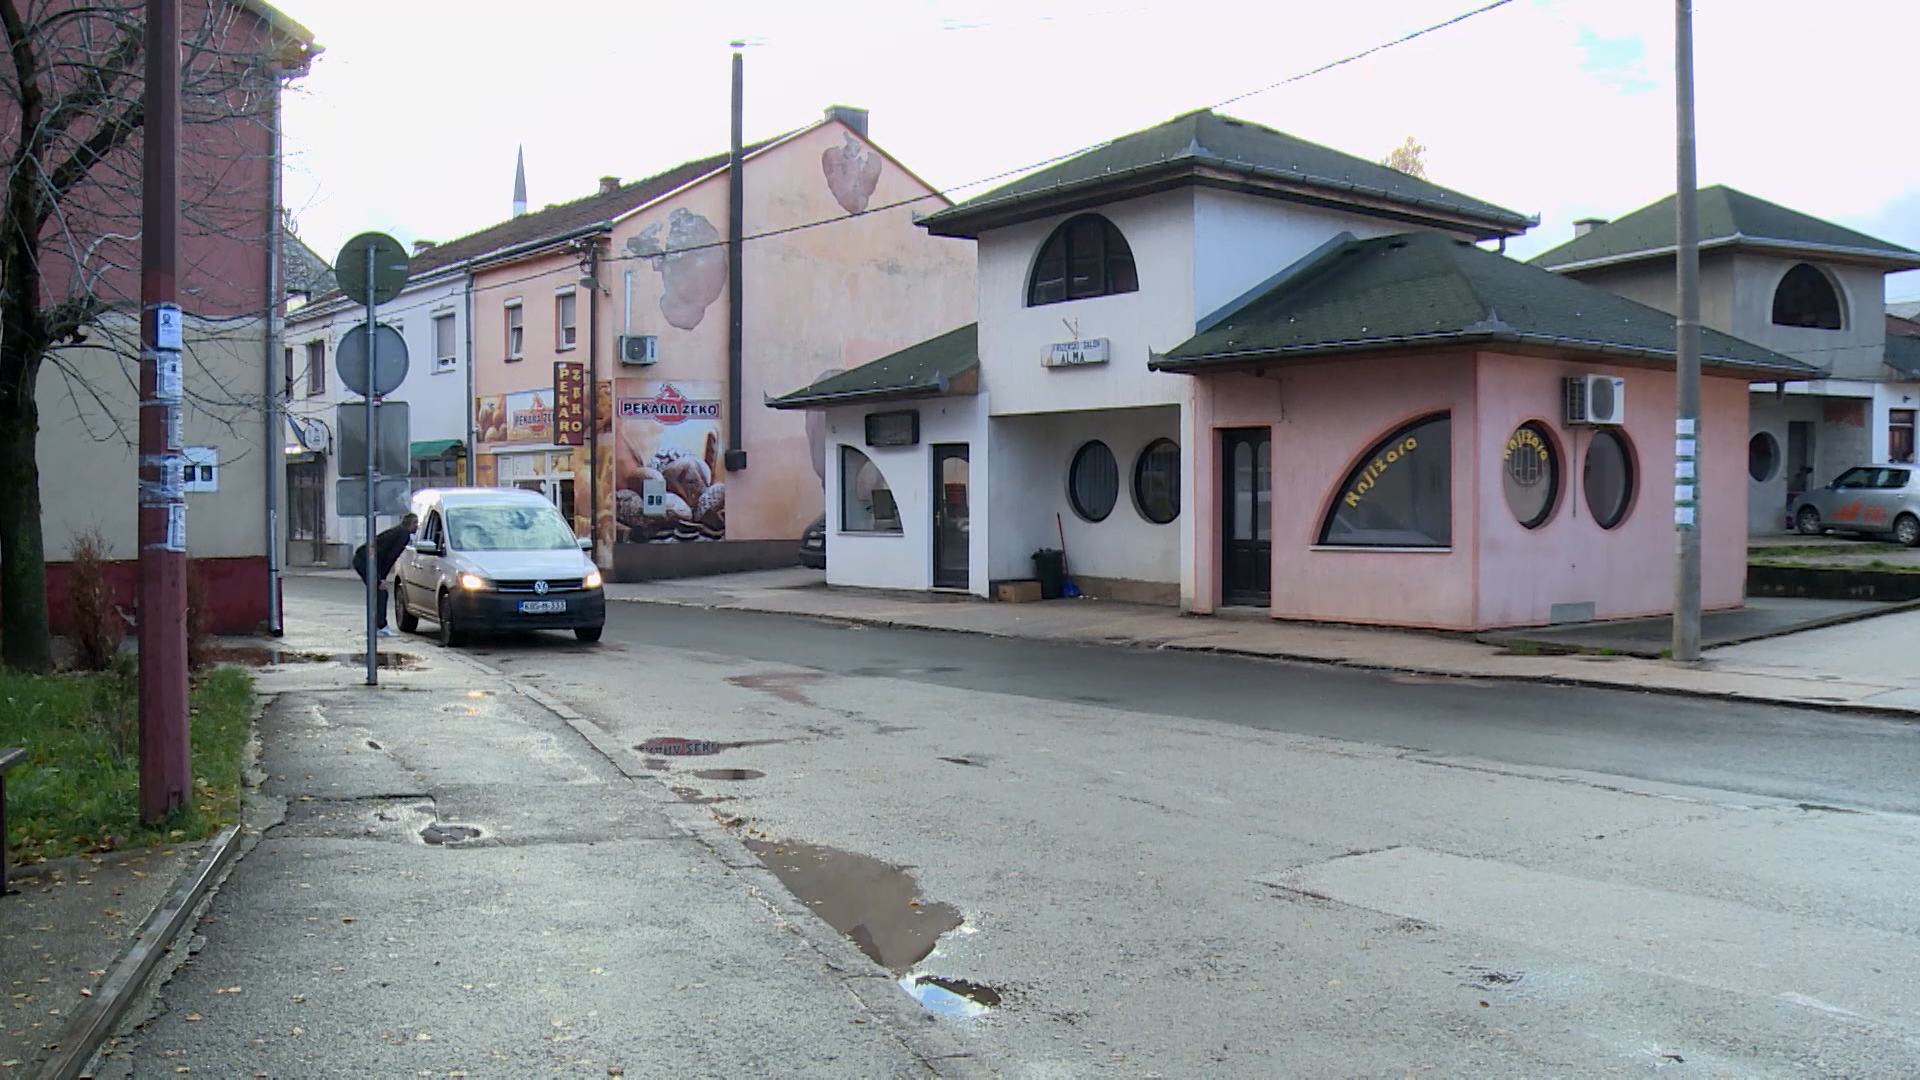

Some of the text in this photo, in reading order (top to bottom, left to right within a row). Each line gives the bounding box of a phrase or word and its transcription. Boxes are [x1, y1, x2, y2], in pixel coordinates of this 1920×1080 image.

[1060, 352, 1085, 364] ALMA
[558, 367, 570, 444] PEKARA
[623, 403, 717, 414] PEKARA ZEKO
